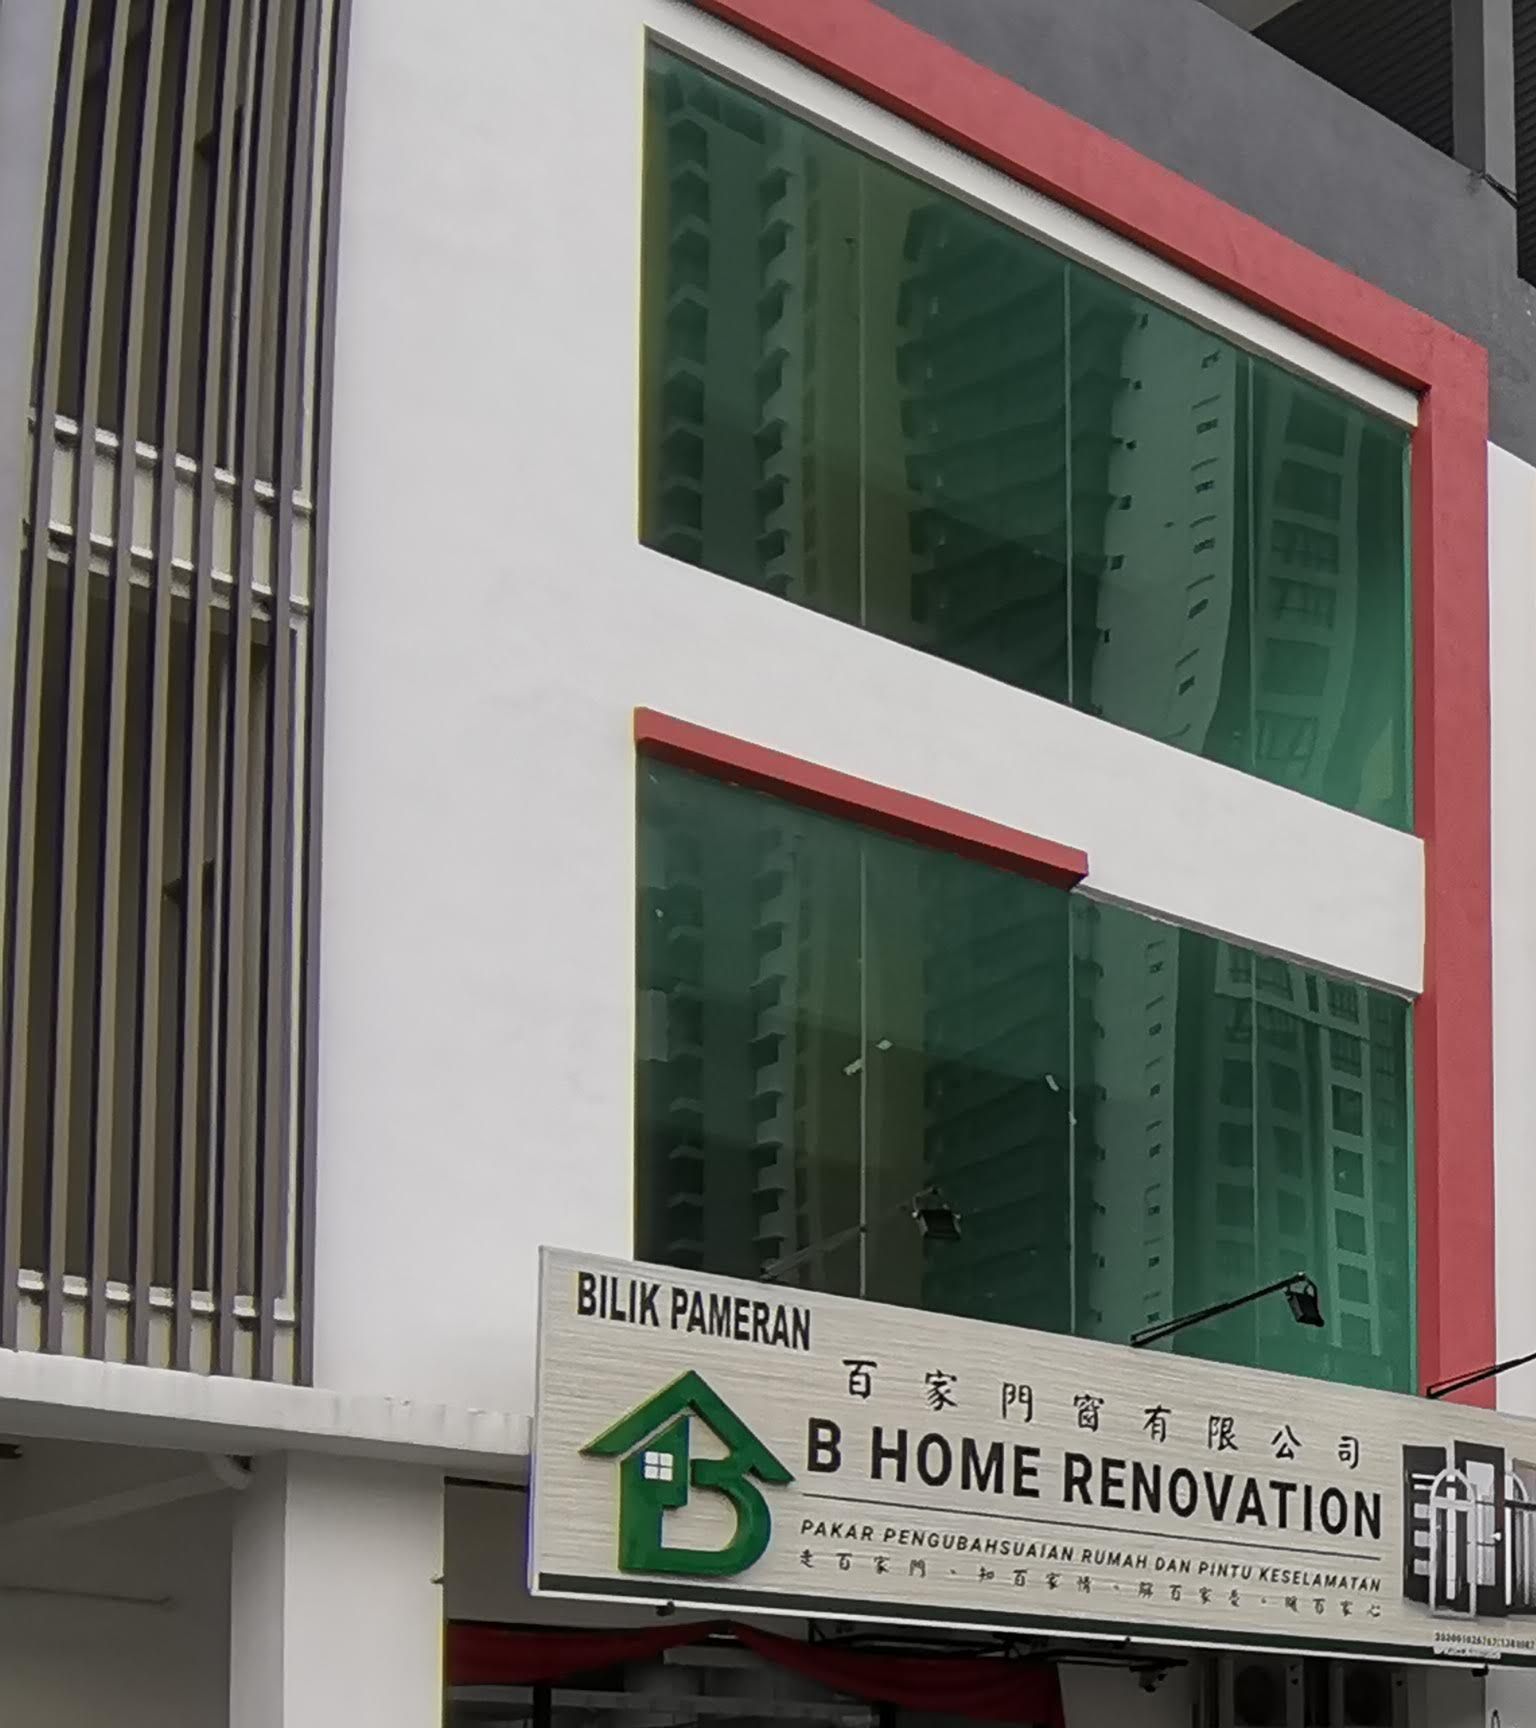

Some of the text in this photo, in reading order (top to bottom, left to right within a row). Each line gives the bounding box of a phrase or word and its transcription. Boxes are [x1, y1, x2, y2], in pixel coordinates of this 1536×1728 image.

[576, 1270, 811, 1351] BILIK PAMERAN
[807, 1416, 1382, 1540] B HOME RENOVATION
[800, 1518, 1381, 1593] PAKAR PENGUBAHSUAIAN RUMAH DAN PINTU KESELAMATAN
